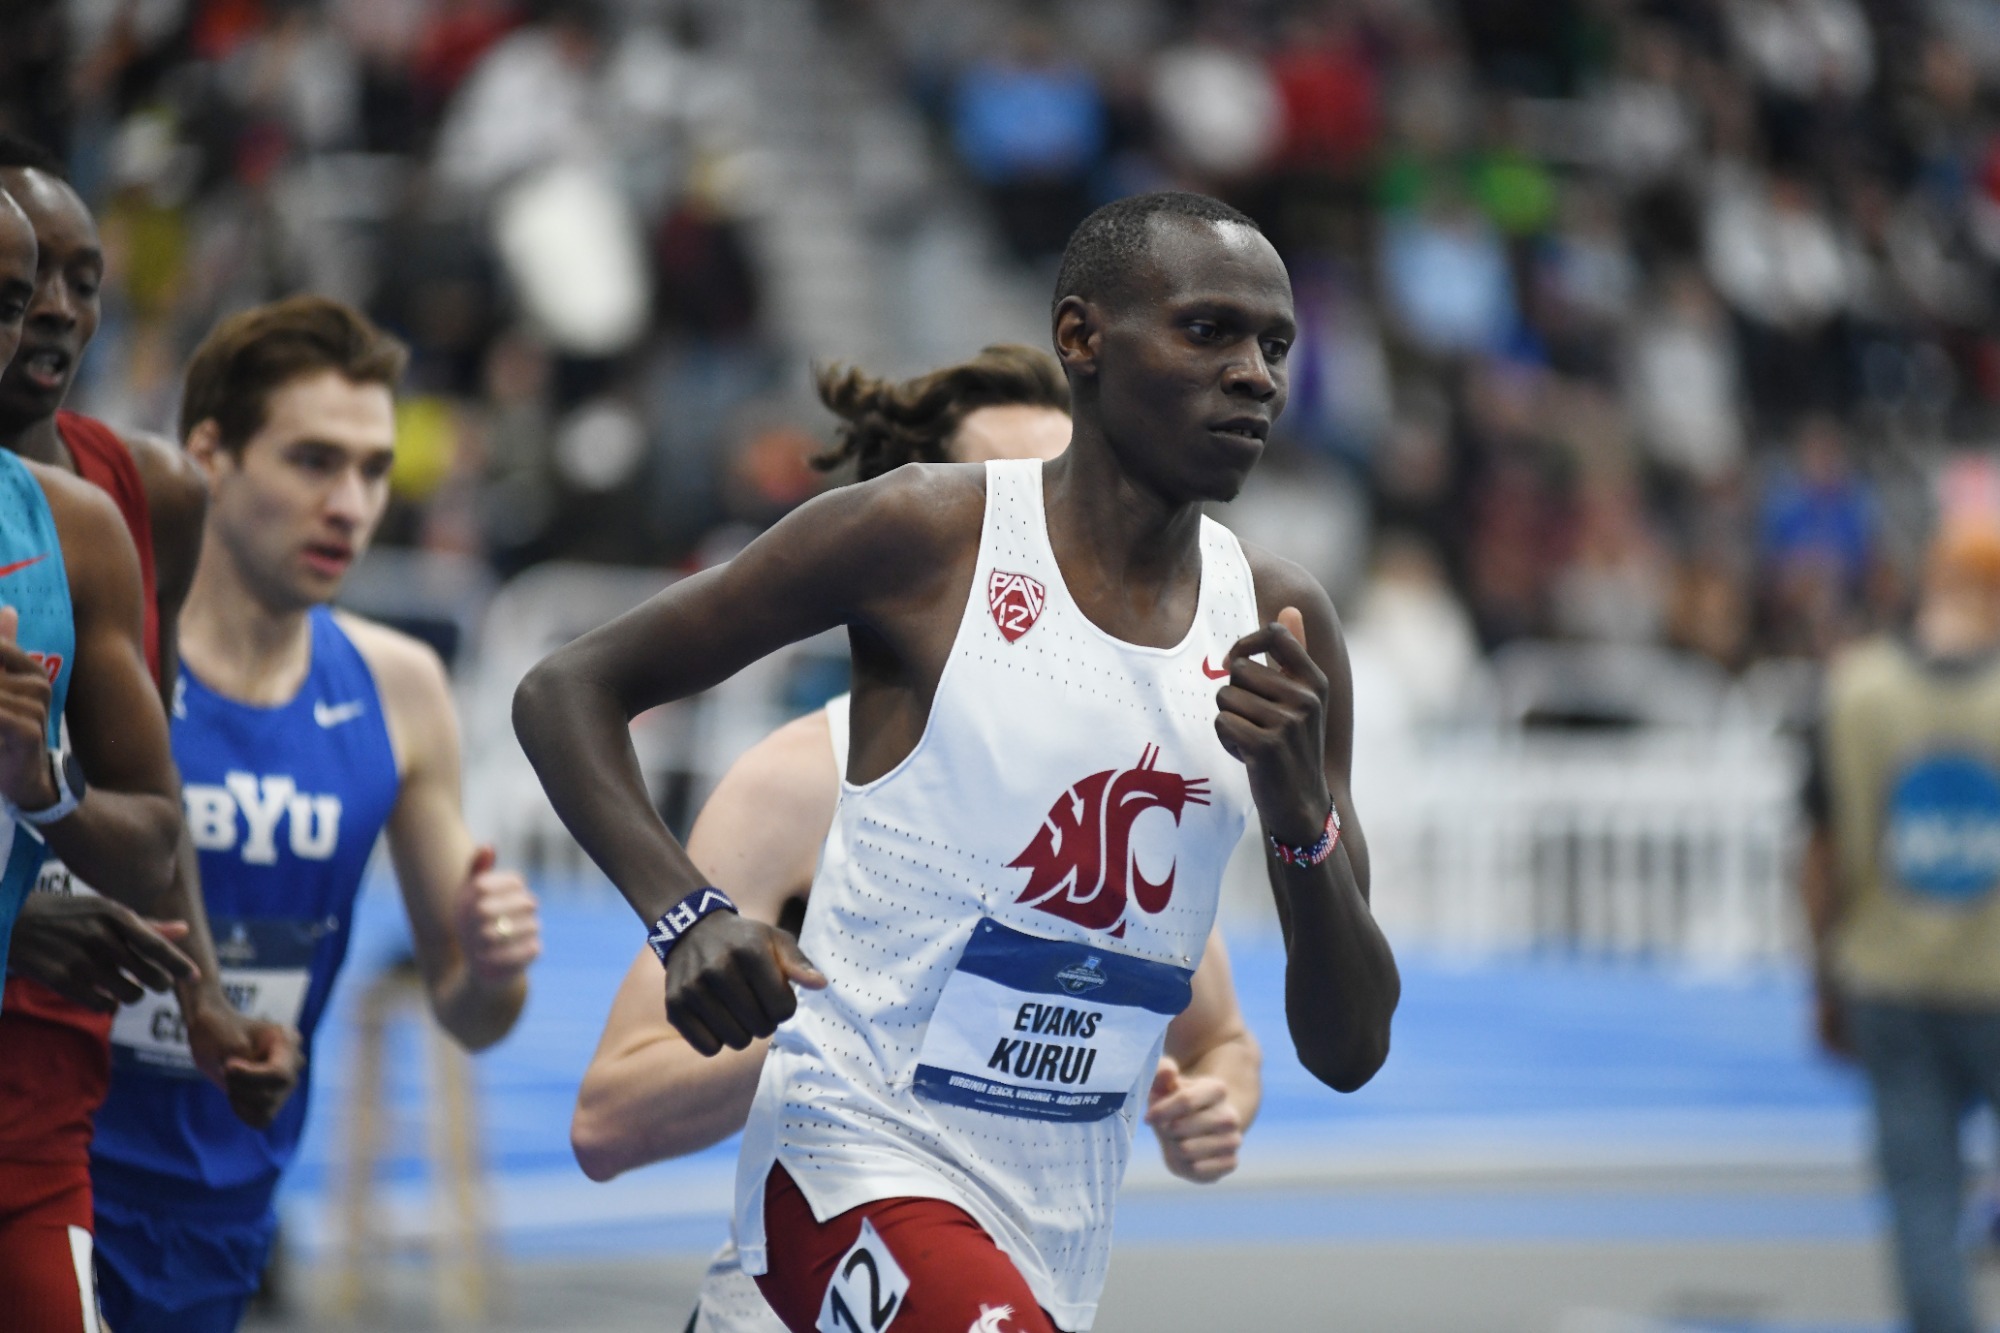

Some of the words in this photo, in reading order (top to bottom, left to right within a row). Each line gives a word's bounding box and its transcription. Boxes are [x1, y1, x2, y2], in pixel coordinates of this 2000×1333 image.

[990, 573, 1044, 620] PAC
[998, 602, 1029, 632] 12
[182, 771, 342, 866] BYU
[1013, 1002, 1103, 1039] EVANS
[987, 1037, 1097, 1085] KURUI
[949, 1075, 987, 1093] VIRGINIA
[987, 1085, 1014, 1099] BEACH,
[1016, 1089, 1051, 1102] VIRGINIA
[830, 1248, 898, 1333] 12
